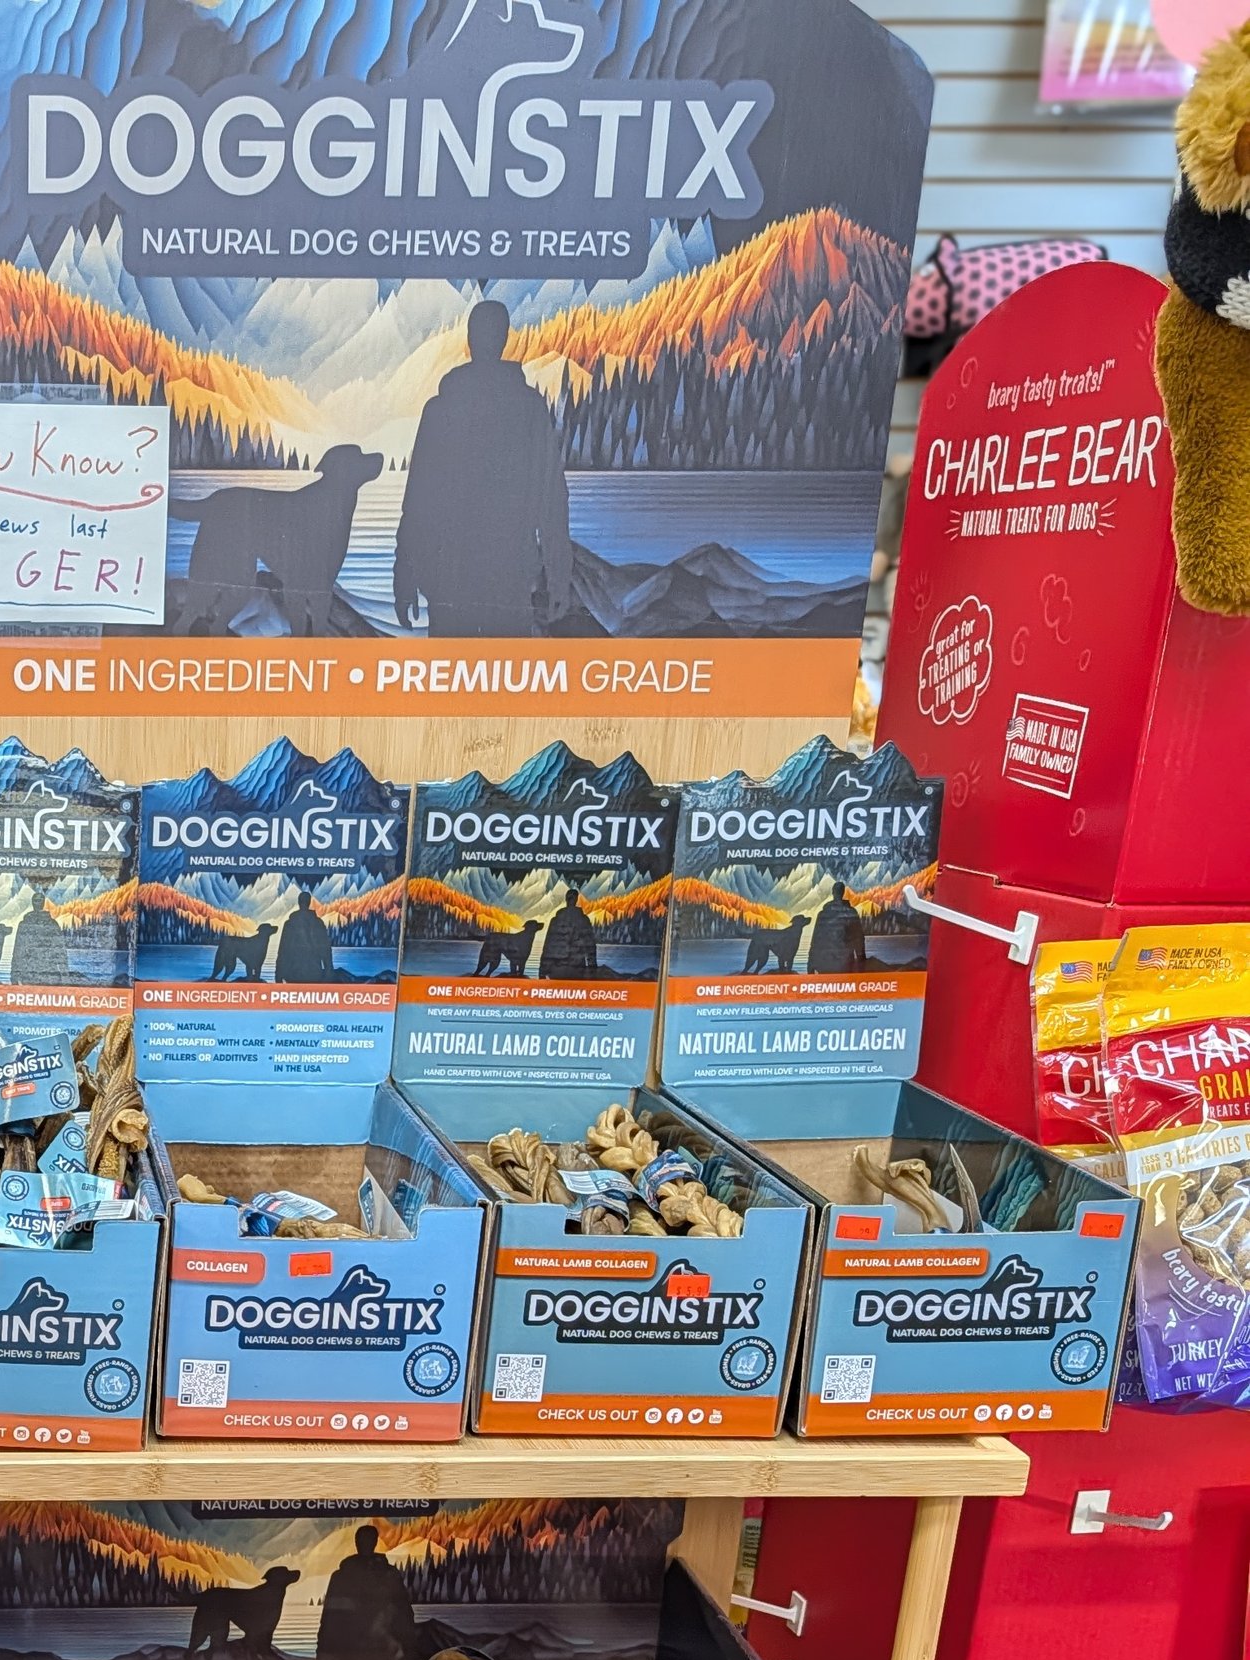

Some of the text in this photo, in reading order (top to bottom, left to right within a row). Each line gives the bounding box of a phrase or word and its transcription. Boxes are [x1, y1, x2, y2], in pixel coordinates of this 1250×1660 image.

[27, 94, 756, 200] DOGGINSTIX
[141, 227, 632, 259] NATURAL DOG CHEWS & TREATS
[987, 381, 1021, 412] beary
[1023, 376, 1057, 408] tasty
[29, 425, 159, 482] Know?
[923, 416, 1162, 500] CHARLEE BEAR
[69, 515, 110, 540] last
[960, 501, 1100, 539] NATURAL TREATS FOR DOGS
[935, 617, 977, 659] great for
[13, 659, 714, 694] ONE INGREDIENT PREMIUM GRADE
[927, 639, 986, 687] TREATING or
[934, 665, 978, 709] TRAINING
[1025, 720, 1078, 752] MADE IN USA
[1009, 743, 1074, 774] FAMILY OWNED
[152, 814, 397, 852] DOGGINSTIX
[425, 810, 665, 849] DOGGINSTIX
[690, 804, 930, 844] DOGGINSTIX
[148, 1022, 216, 1032] 100% NATURAL
[148, 1037, 266, 1047] HAND CRAFTED WITH CARE
[148, 1053, 258, 1063] NO FILLERS OR ADDITIVES
[408, 1031, 636, 1060] NATURAL LAMB COLLAGEN
[186, 1260, 248, 1275] COLLAGEN
[206, 1295, 445, 1333] DOGGINSTIX
[525, 1293, 763, 1328] DOGGINSTIX
[857, 1288, 1095, 1324] DOGGINSTIX
